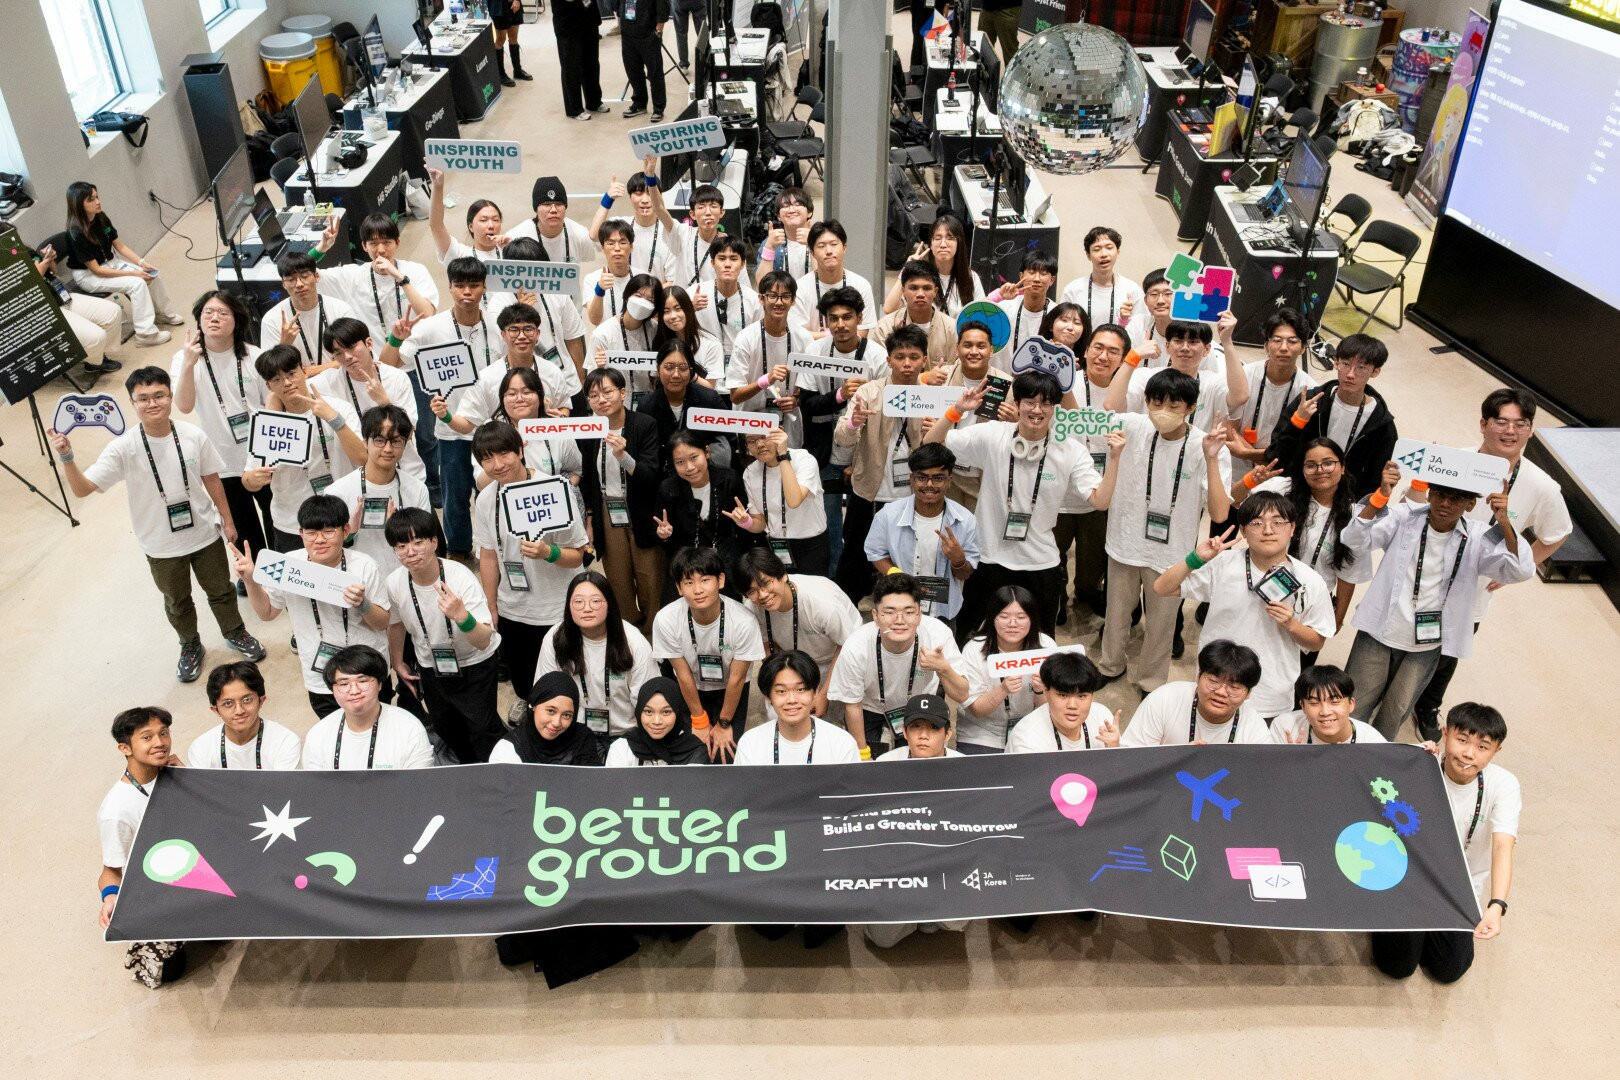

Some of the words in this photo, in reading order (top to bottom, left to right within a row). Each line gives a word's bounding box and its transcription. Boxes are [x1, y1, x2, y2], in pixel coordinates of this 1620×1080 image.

[631, 121, 718, 145] INSPIRING
[428, 144, 518, 157] INSPIRING
[649, 136, 708, 154] YOUTH
[444, 158, 504, 170] YOUTH
[486, 264, 577, 279] INSPIRING
[500, 278, 560, 291] YOUTH
[427, 355, 464, 370] LEVEL
[609, 356, 657, 365] KRAFT
[793, 359, 863, 374] KRAFTON
[438, 369, 459, 381] UP!
[693, 415, 772, 428] KRAFTON
[1056, 407, 1114, 423] better
[262, 425, 300, 440] LEVEL
[525, 424, 602, 434] KRAFTON
[1055, 420, 1123, 442] ground
[269, 440, 291, 453] UP!
[1429, 455, 1443, 464] JA
[1428, 465, 1459, 477] Korea
[515, 493, 558, 510] LEVEL
[527, 509, 551, 523] UP!
[289, 567, 301, 576] JA
[288, 576, 315, 589] Korea
[995, 656, 1049, 670] KRAF
[920, 699, 929, 709] C
[532, 790, 749, 845] better
[823, 822, 862, 836] Build
[864, 823, 875, 831] a
[877, 819, 938, 831] Greater
[940, 820, 1018, 832] Tomorrow
[524, 830, 787, 907] ground
[825, 876, 928, 891] KRAFTON
[984, 879, 1007, 887] Korea
